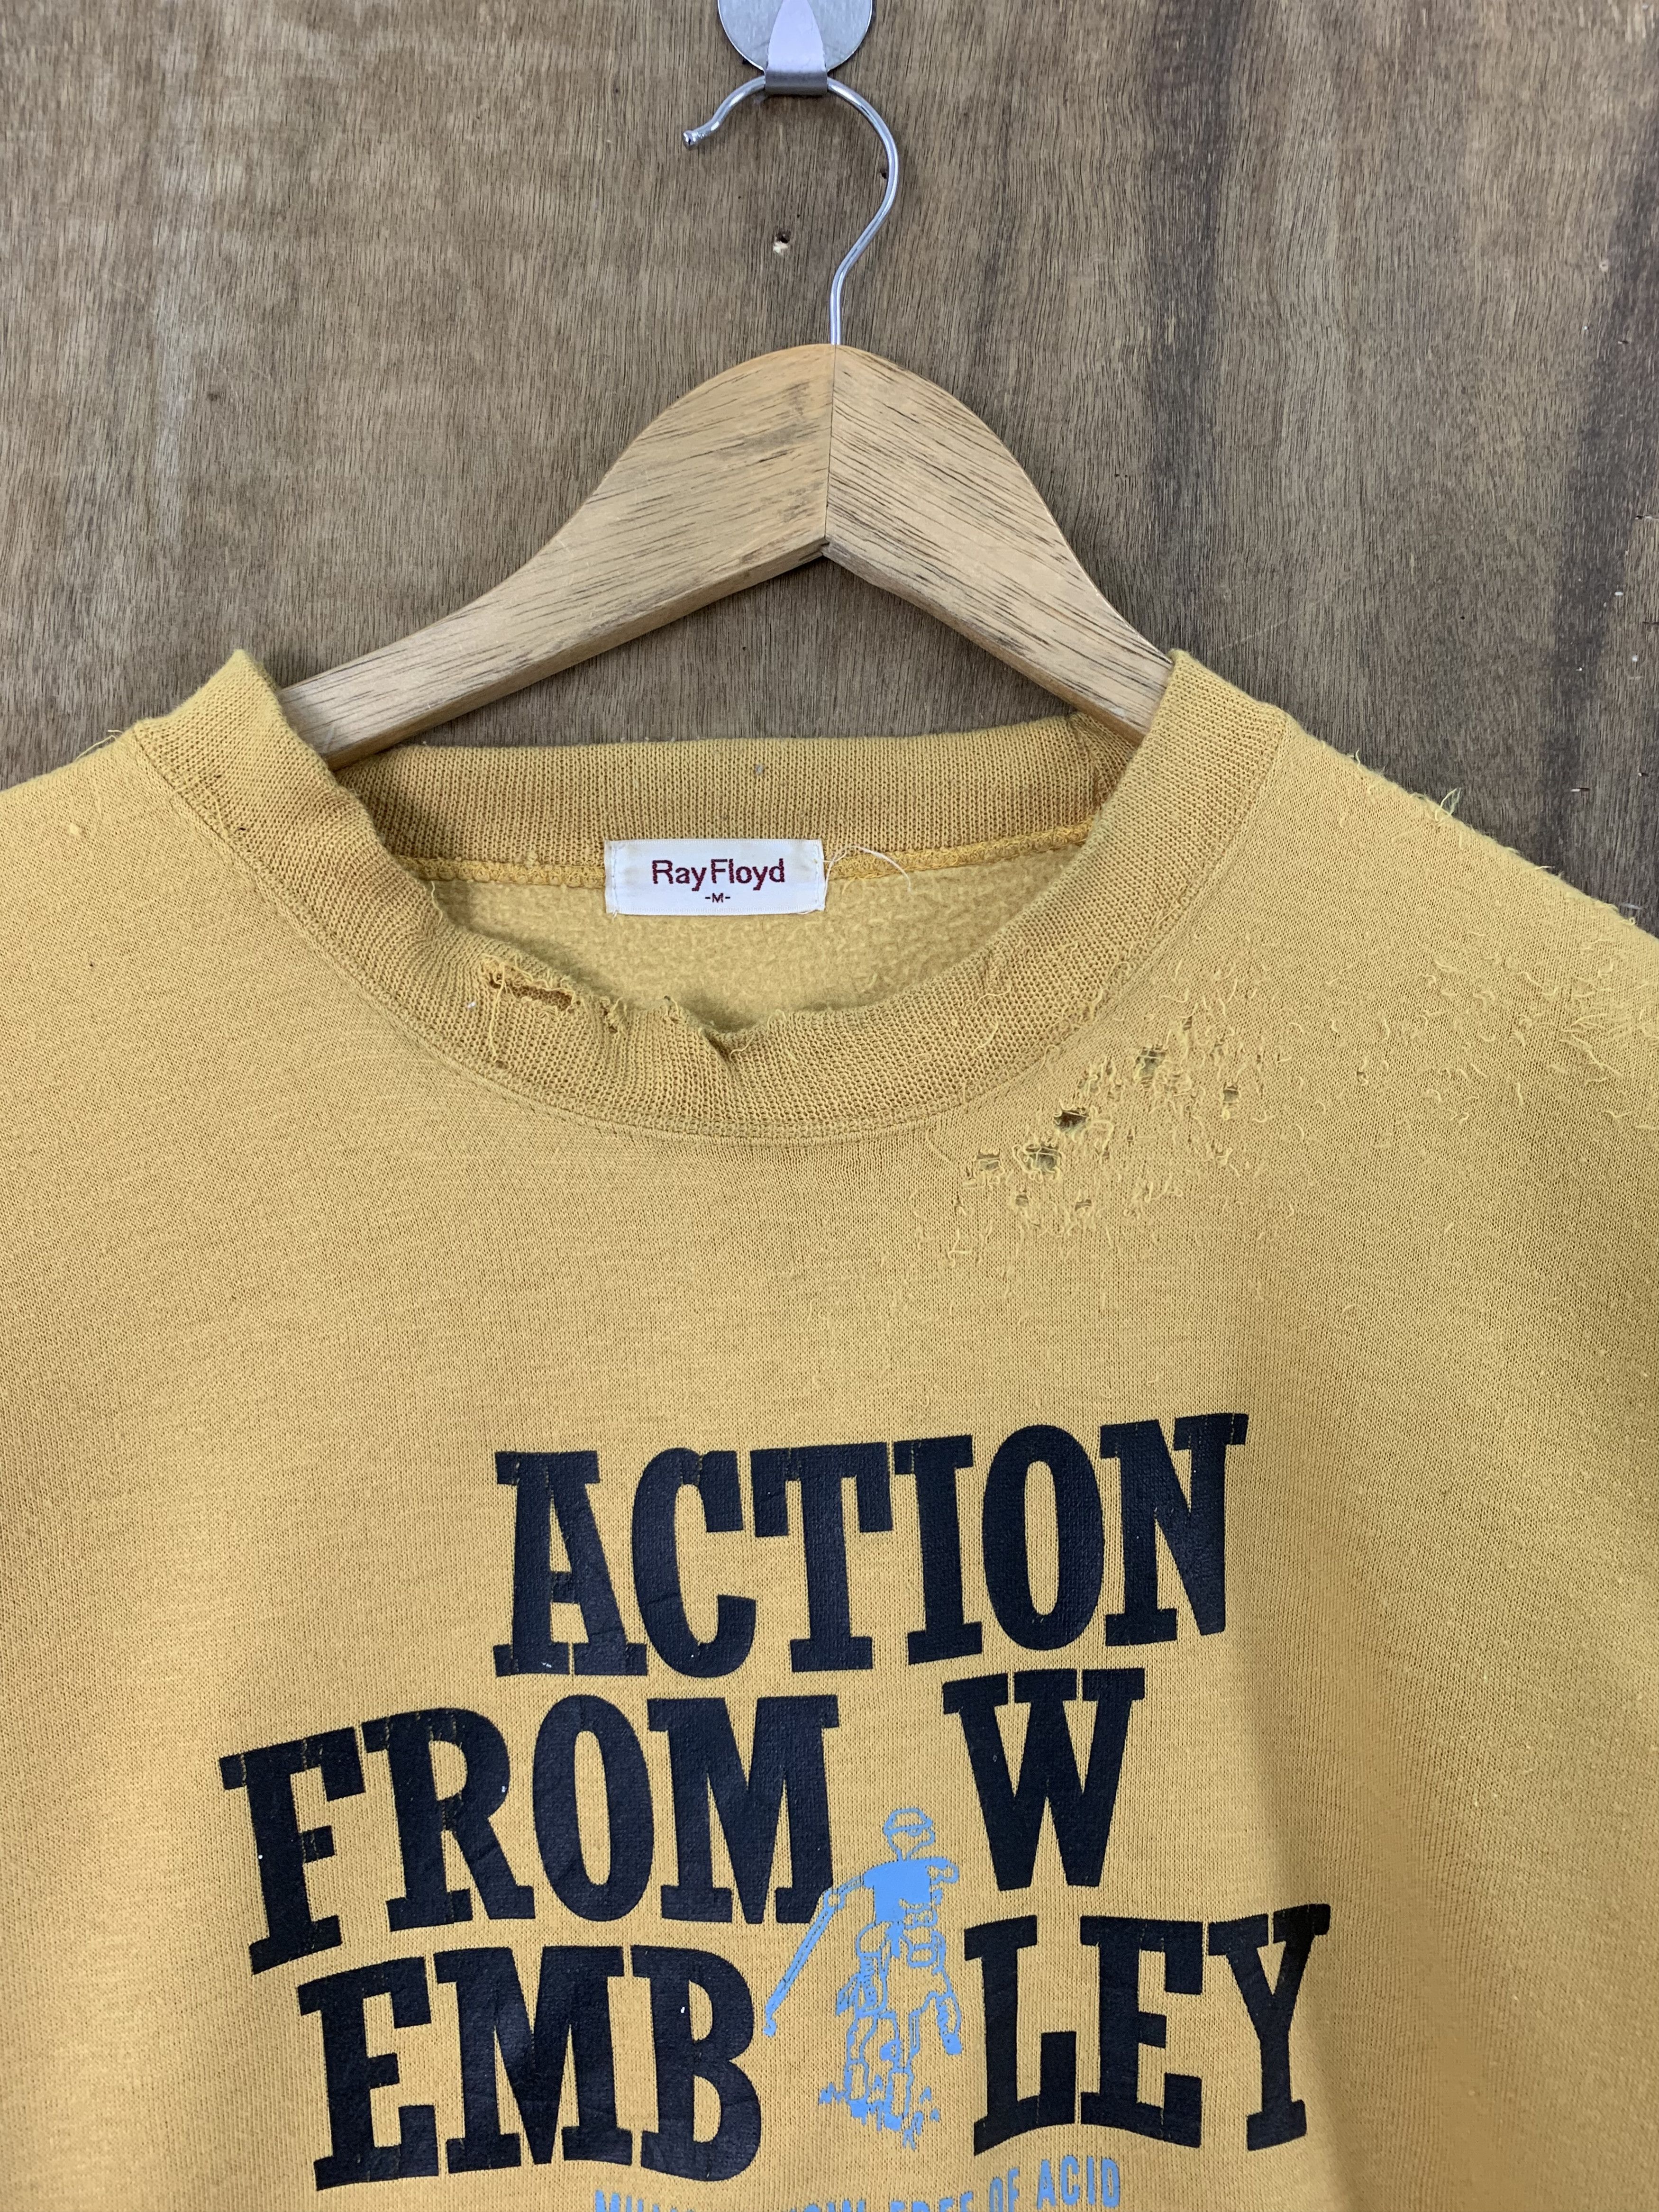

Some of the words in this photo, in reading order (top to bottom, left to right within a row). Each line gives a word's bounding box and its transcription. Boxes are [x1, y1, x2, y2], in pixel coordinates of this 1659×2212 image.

[492, 1411, 1249, 1678] ACTION
[219, 1693, 842, 1977] FROM
[940, 1666, 1148, 1892] W
[297, 1944, 762, 2192] EMB
[964, 1900, 1332, 2157] LEY
[989, 2167, 1019, 2212] OF
[1037, 2155, 1120, 2209] ACID
